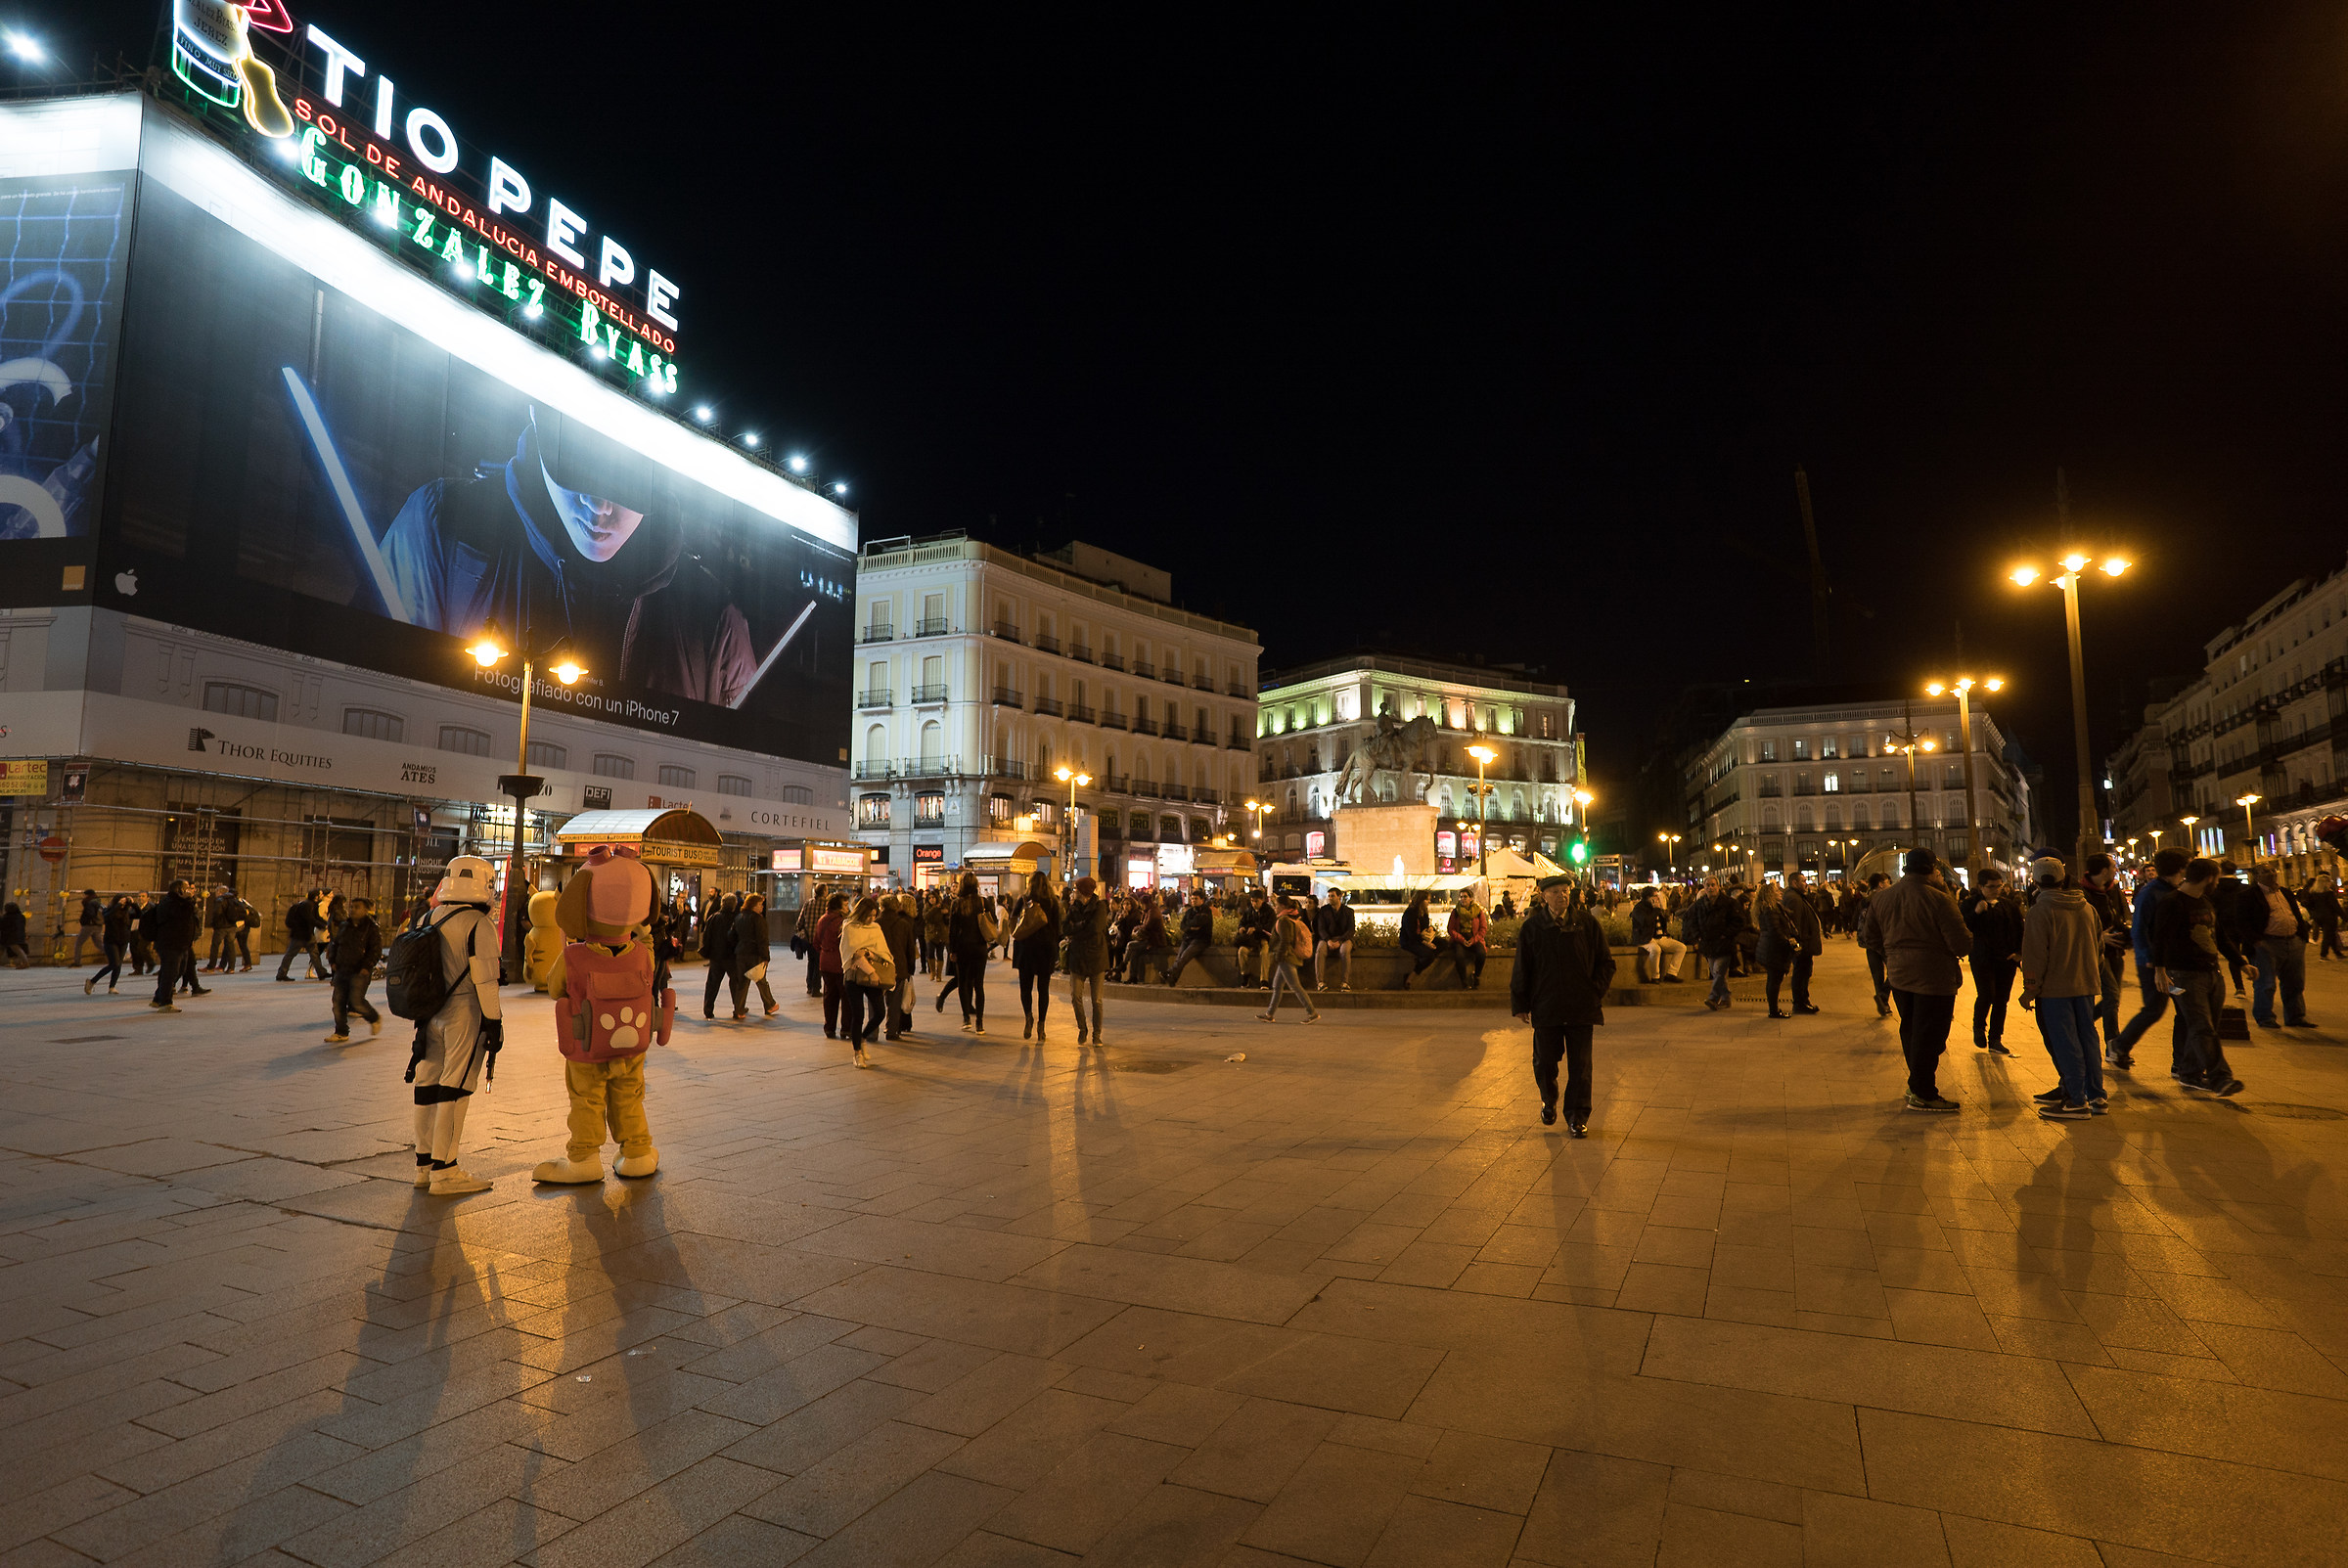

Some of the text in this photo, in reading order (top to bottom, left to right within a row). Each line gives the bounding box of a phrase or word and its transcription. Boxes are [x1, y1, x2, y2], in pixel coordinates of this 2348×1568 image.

[194, 17, 228, 46] JEREZ
[180, 36, 202, 59] FINO
[204, 58, 222, 73] MUY
[307, 23, 680, 332] TIO PEPE
[294, 98, 676, 354] SOL DE ANDALUCIA EMBOTELLADO
[300, 126, 679, 394] GONZALEZ BYASS
[474, 662, 680, 726] Fotogfiado con un iPhone 7
[217, 739, 333, 769] THOR EQUITIES
[8, 762, 46, 773] Lartec
[401, 771, 435, 784] ATES
[402, 762, 436, 774] ANDAMIOS
[585, 786, 610, 800] DEFI
[750, 811, 831, 831] CORTEFIEL
[652, 845, 682, 858] TOURIST
[684, 849, 699, 860] BUS
[828, 856, 860, 867] TABACOS
[916, 848, 942, 860] Orange
